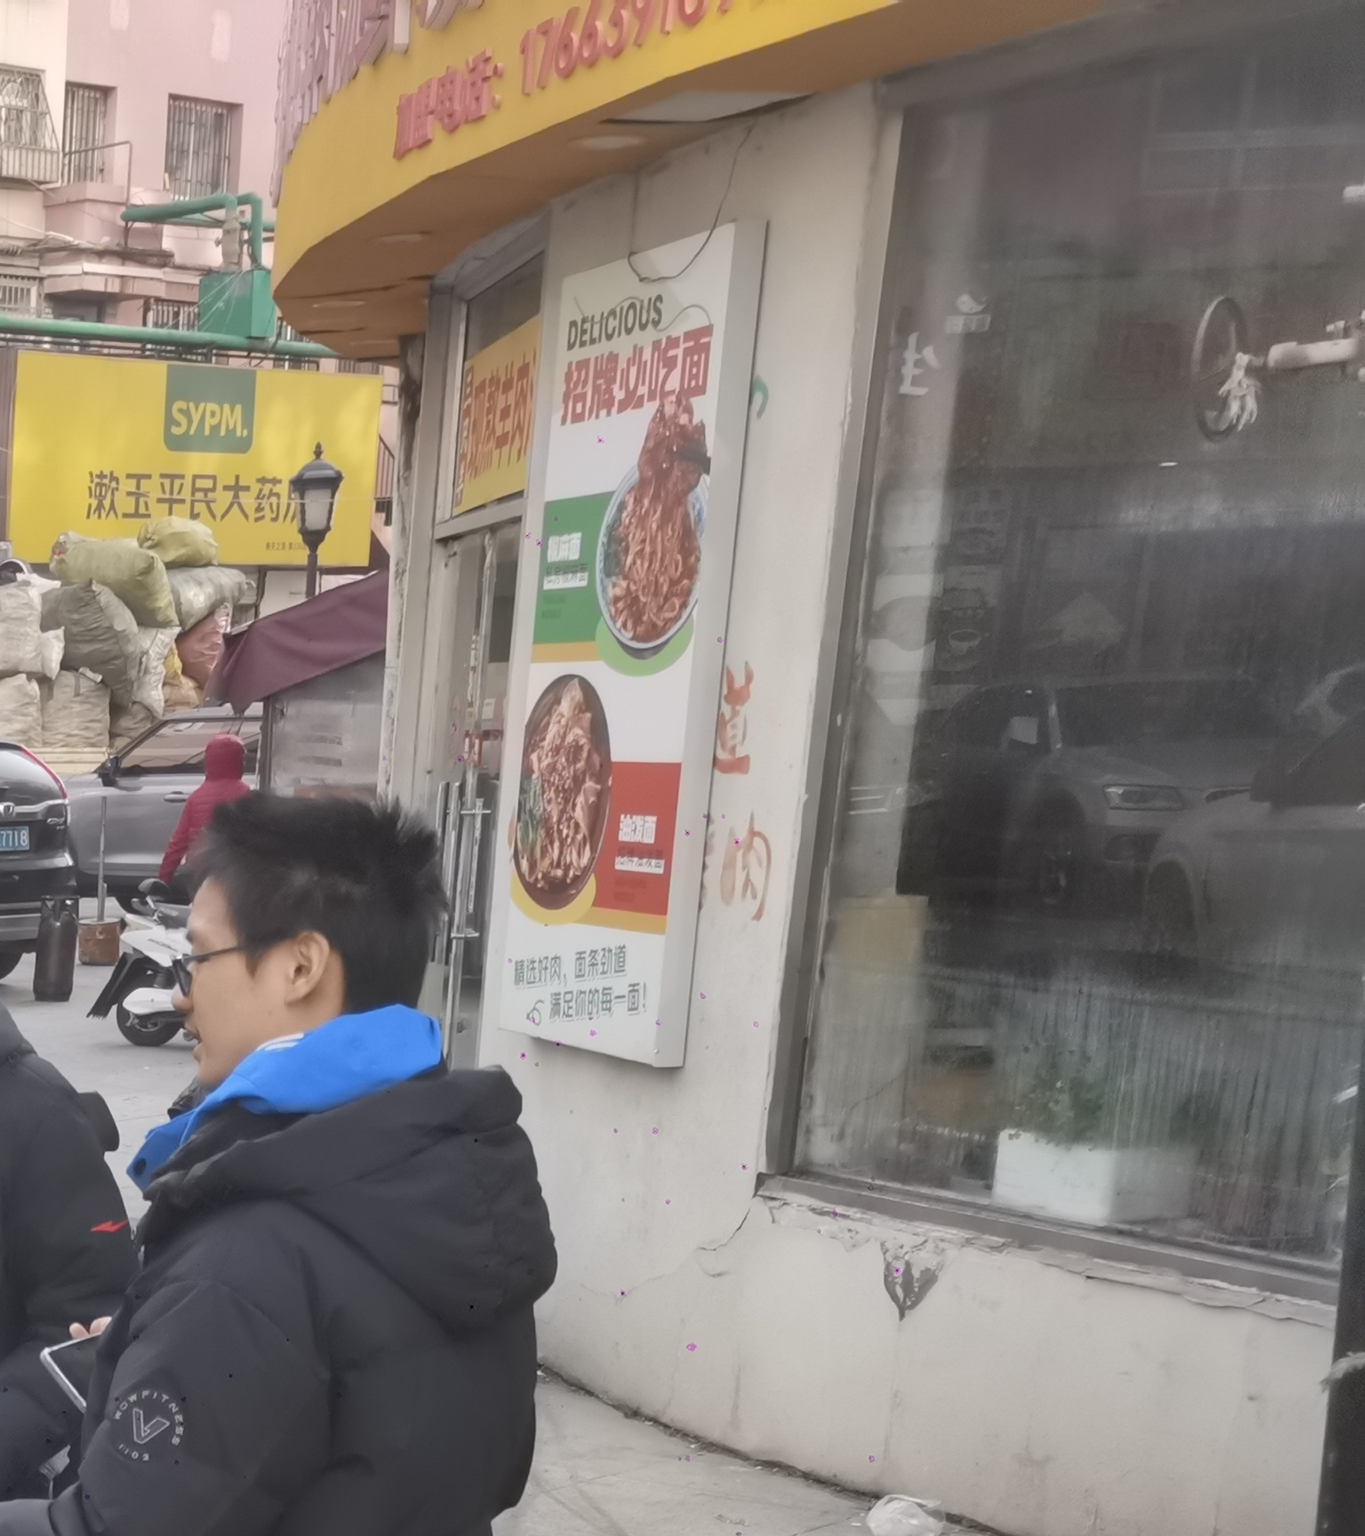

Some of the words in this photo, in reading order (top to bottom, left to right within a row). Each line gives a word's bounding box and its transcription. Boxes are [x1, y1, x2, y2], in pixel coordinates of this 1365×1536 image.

[519, 0, 731, 95] 176639
[567, 294, 664, 351] DELICIOUS
[560, 324, 714, 426] 招牌必吃面
